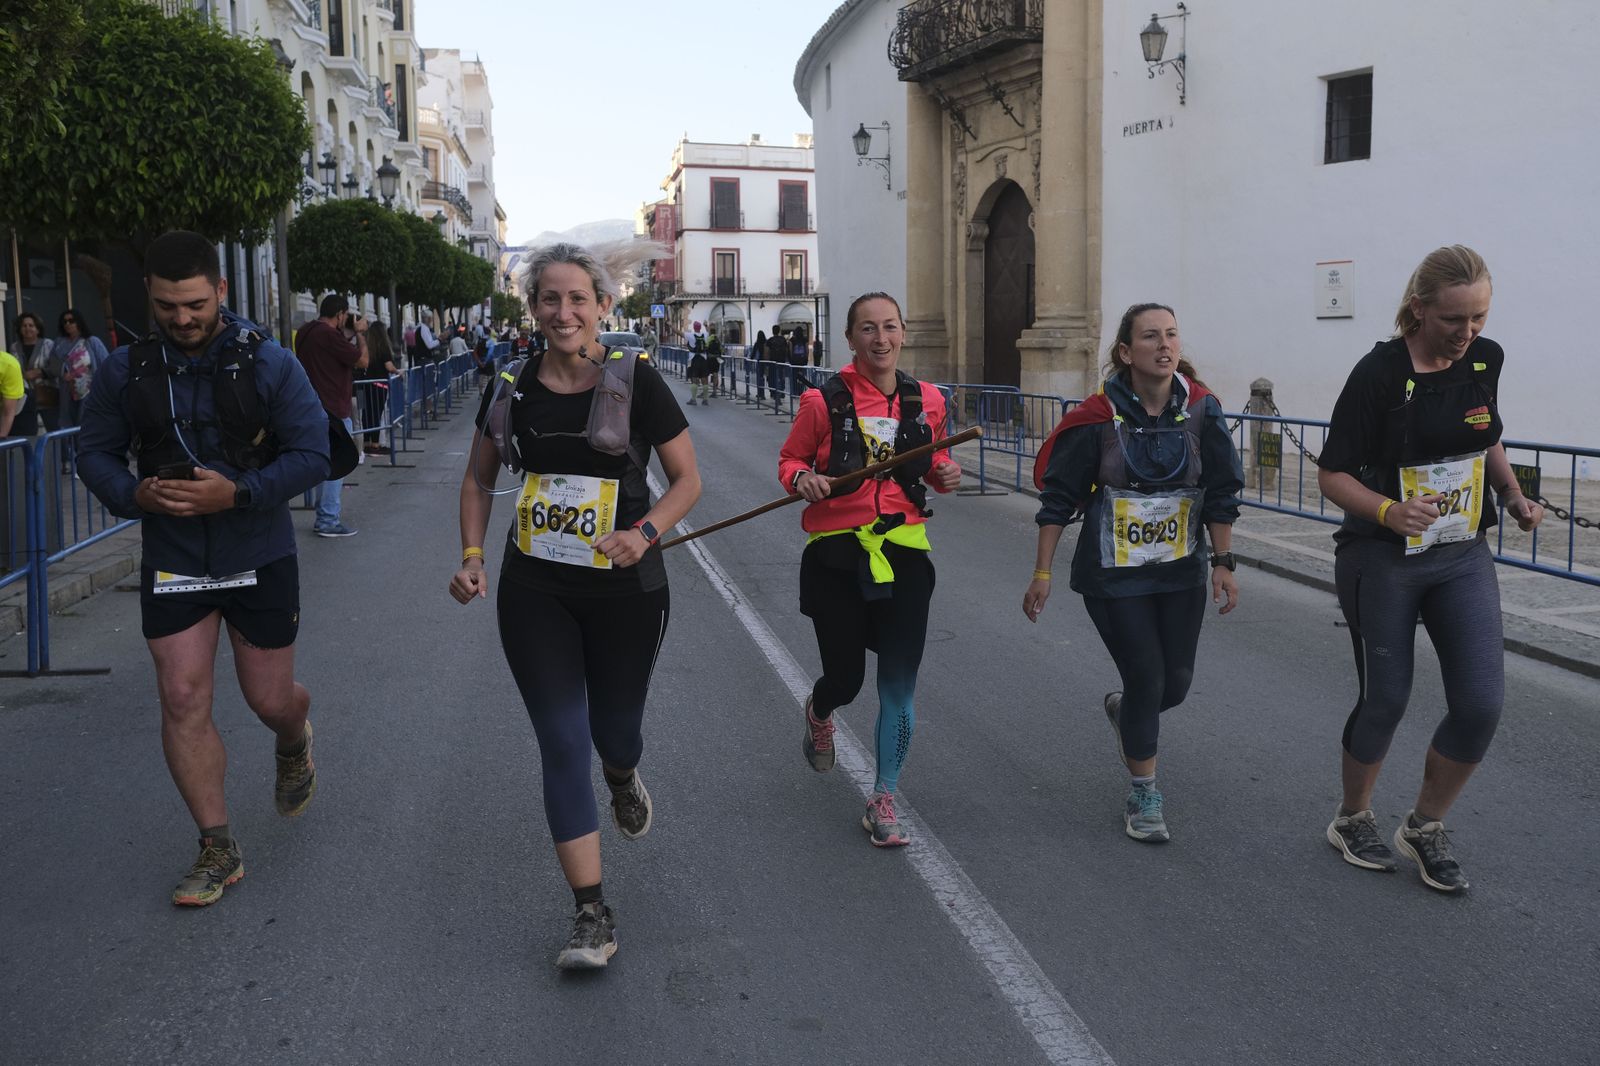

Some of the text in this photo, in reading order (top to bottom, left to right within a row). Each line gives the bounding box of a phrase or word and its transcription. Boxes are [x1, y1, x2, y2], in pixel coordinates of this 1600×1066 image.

[1122, 119, 1163, 137] PUERTA
[1423, 486, 1473, 517] 627
[531, 501, 597, 537] 6628
[1127, 519, 1178, 545] 6629
